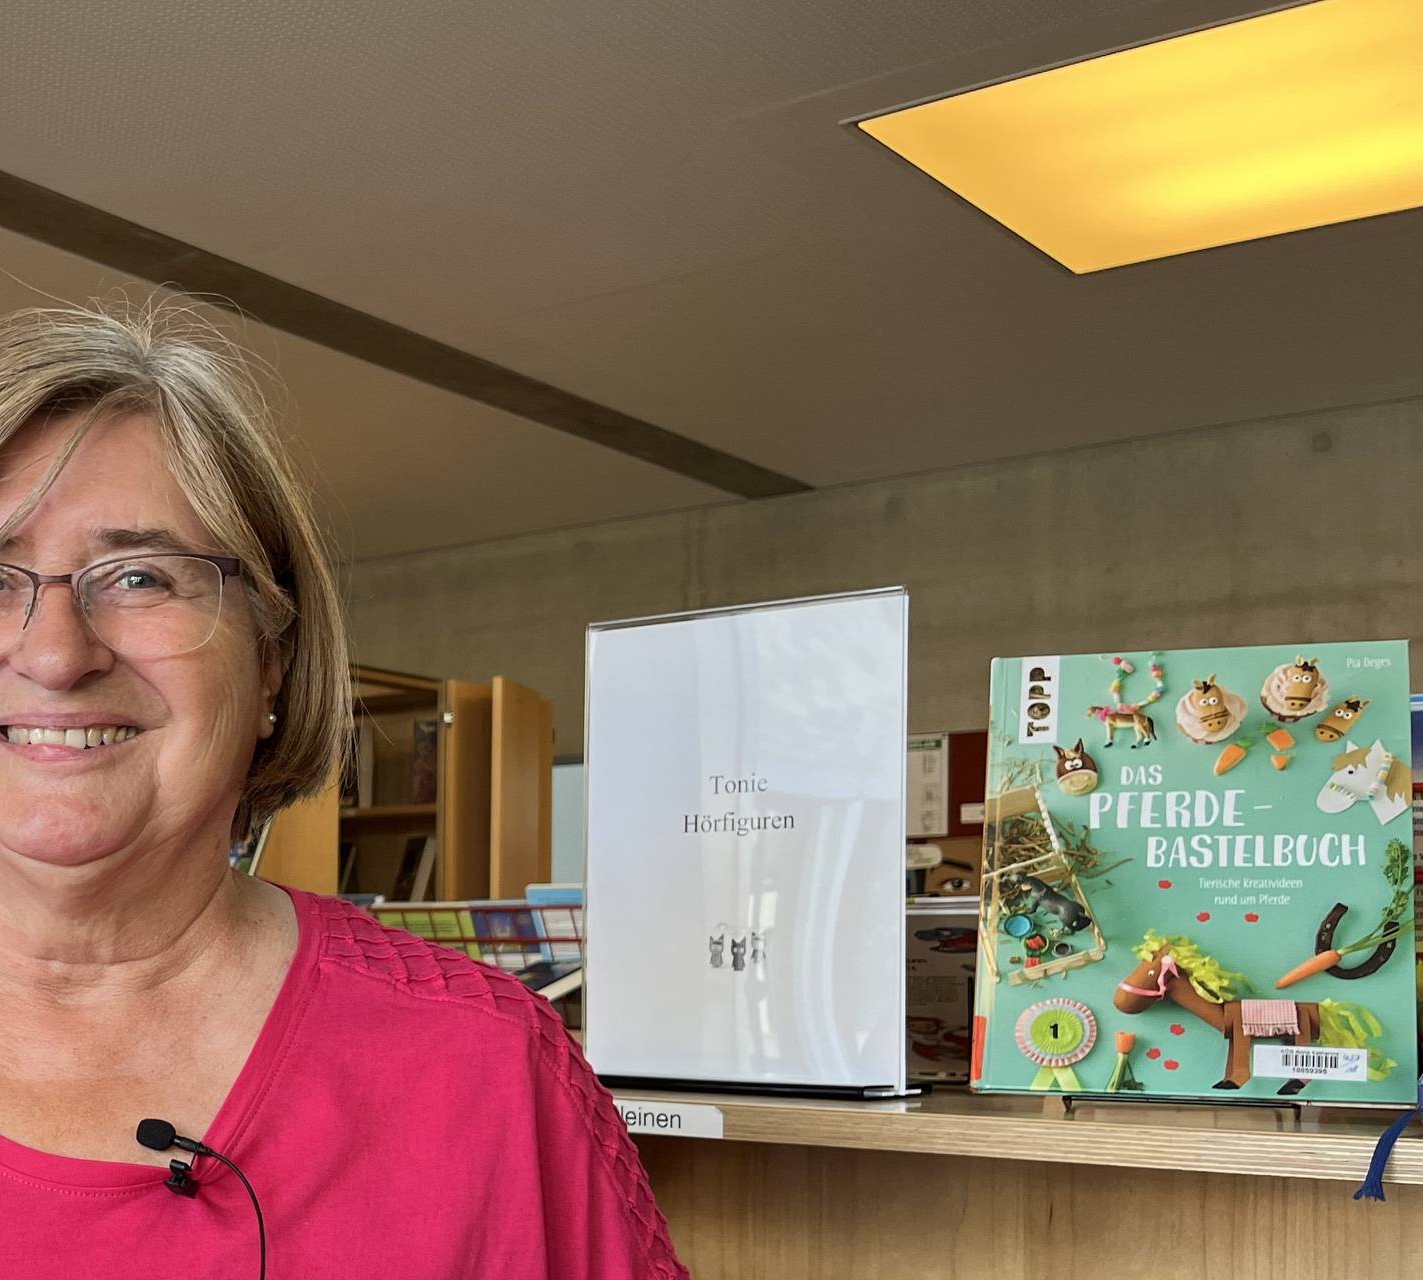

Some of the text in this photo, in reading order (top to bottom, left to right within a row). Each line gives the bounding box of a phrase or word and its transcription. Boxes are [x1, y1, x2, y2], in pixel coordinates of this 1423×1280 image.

[1027, 667, 1051, 737] TOPP
[709, 772, 769, 794] Tonie
[1120, 764, 1163, 786] DAS
[684, 812, 795, 837] Hörfiguren
[1146, 833, 1366, 868] BASTELBUCH
[1198, 877, 1303, 889] Tierische Kreativideen
[1214, 894, 1291, 905] rund um Pferde
[1050, 1023, 1058, 1039] 1
